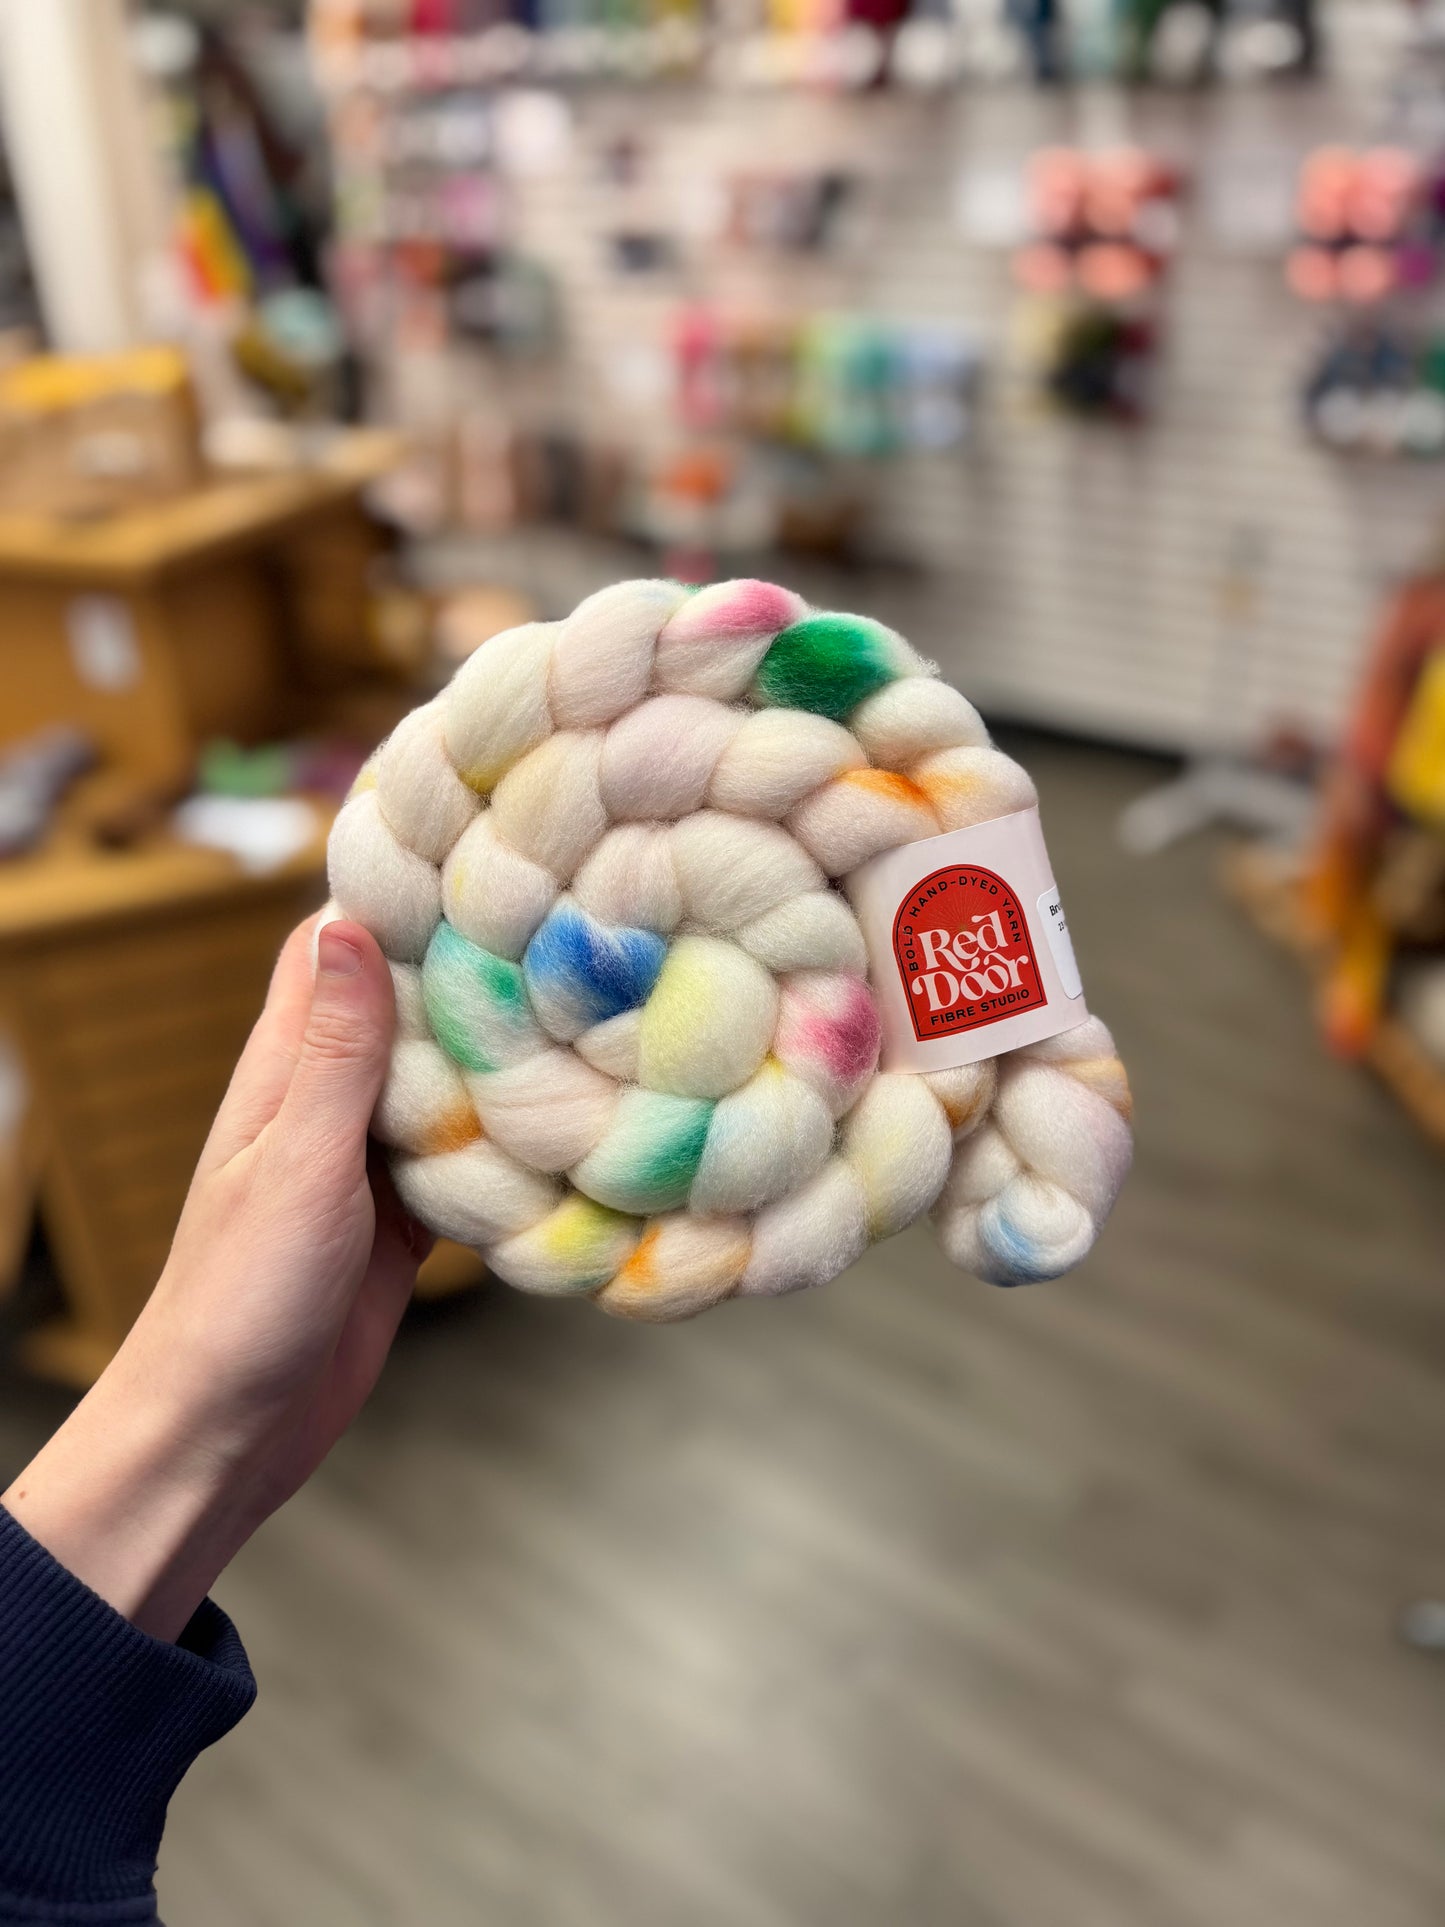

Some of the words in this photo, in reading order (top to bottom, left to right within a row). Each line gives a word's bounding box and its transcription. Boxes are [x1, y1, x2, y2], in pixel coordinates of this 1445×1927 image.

[909, 875, 999, 918] HAND-DYED
[917, 909, 1009, 972] Red
[1002, 898, 1022, 943] YARN
[902, 925, 919, 972] BOLD
[930, 1005, 976, 1026] FIBRE
[980, 988, 1030, 1012] STUDIO
